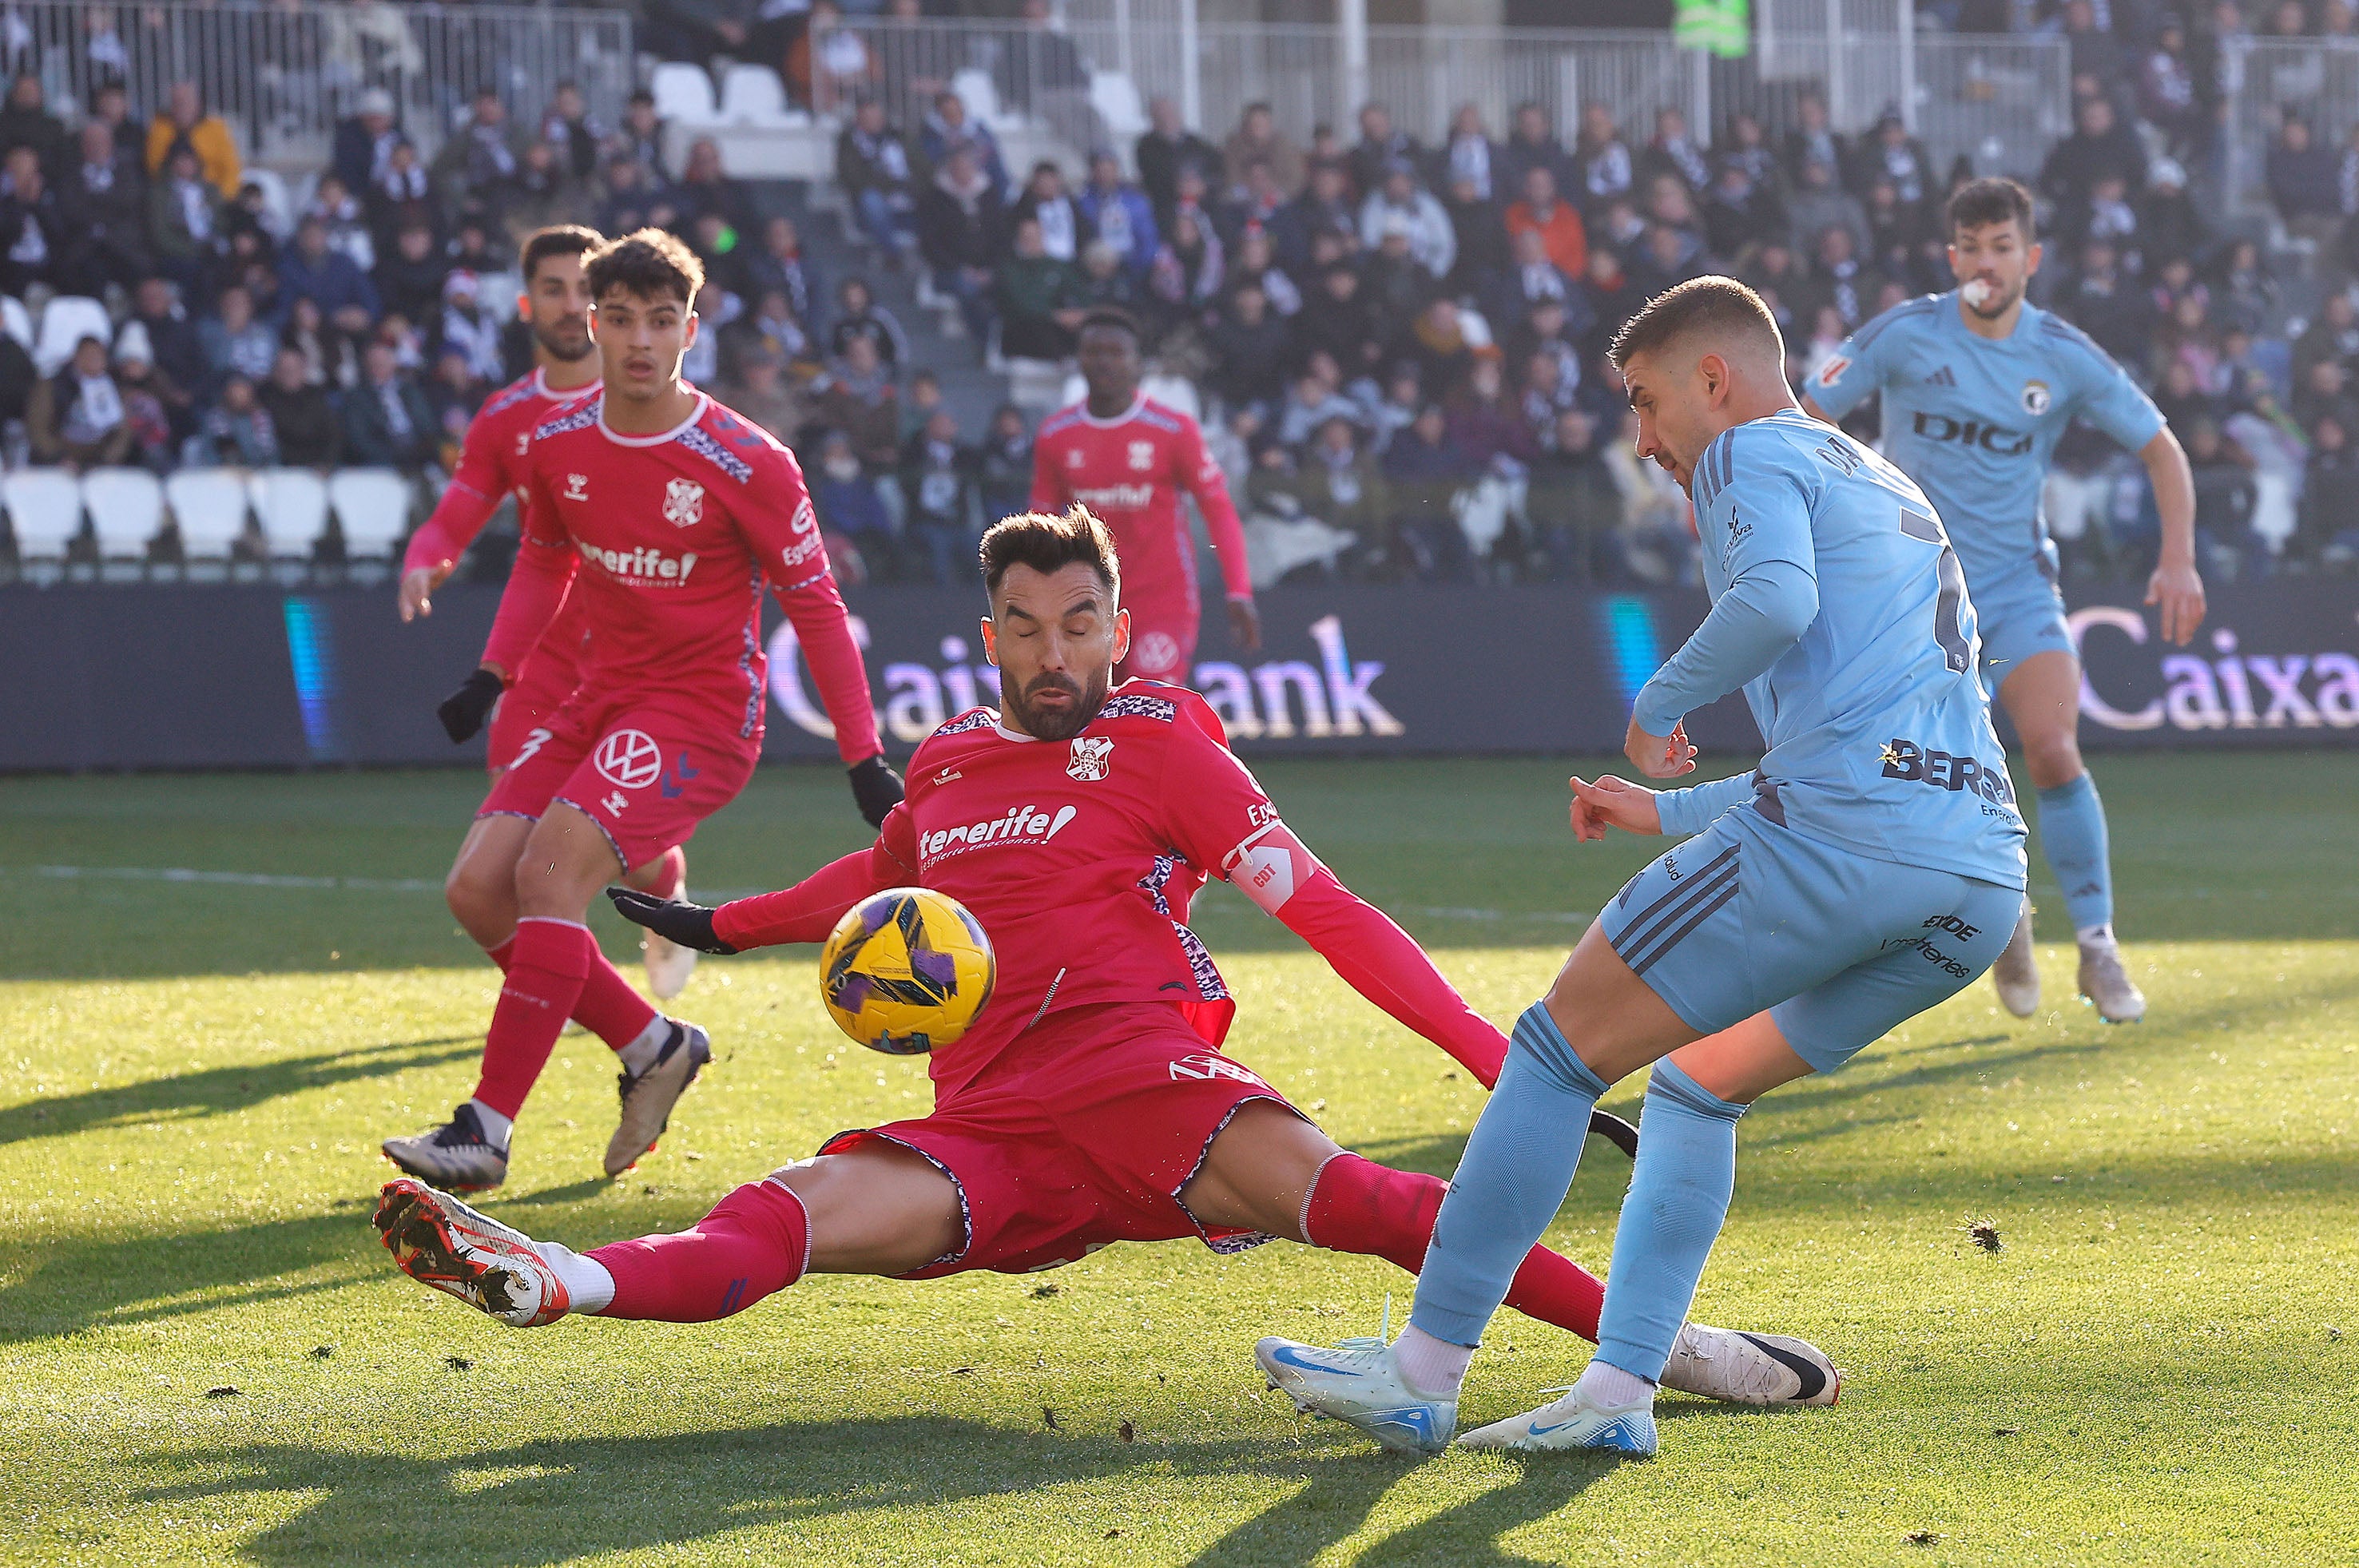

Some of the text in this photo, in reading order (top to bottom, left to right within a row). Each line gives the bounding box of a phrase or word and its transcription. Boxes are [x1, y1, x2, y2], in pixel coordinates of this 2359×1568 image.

[919, 804, 1077, 860] tenerife!
[1253, 863, 1277, 888] CDT
[1664, 855, 1684, 881] salud
